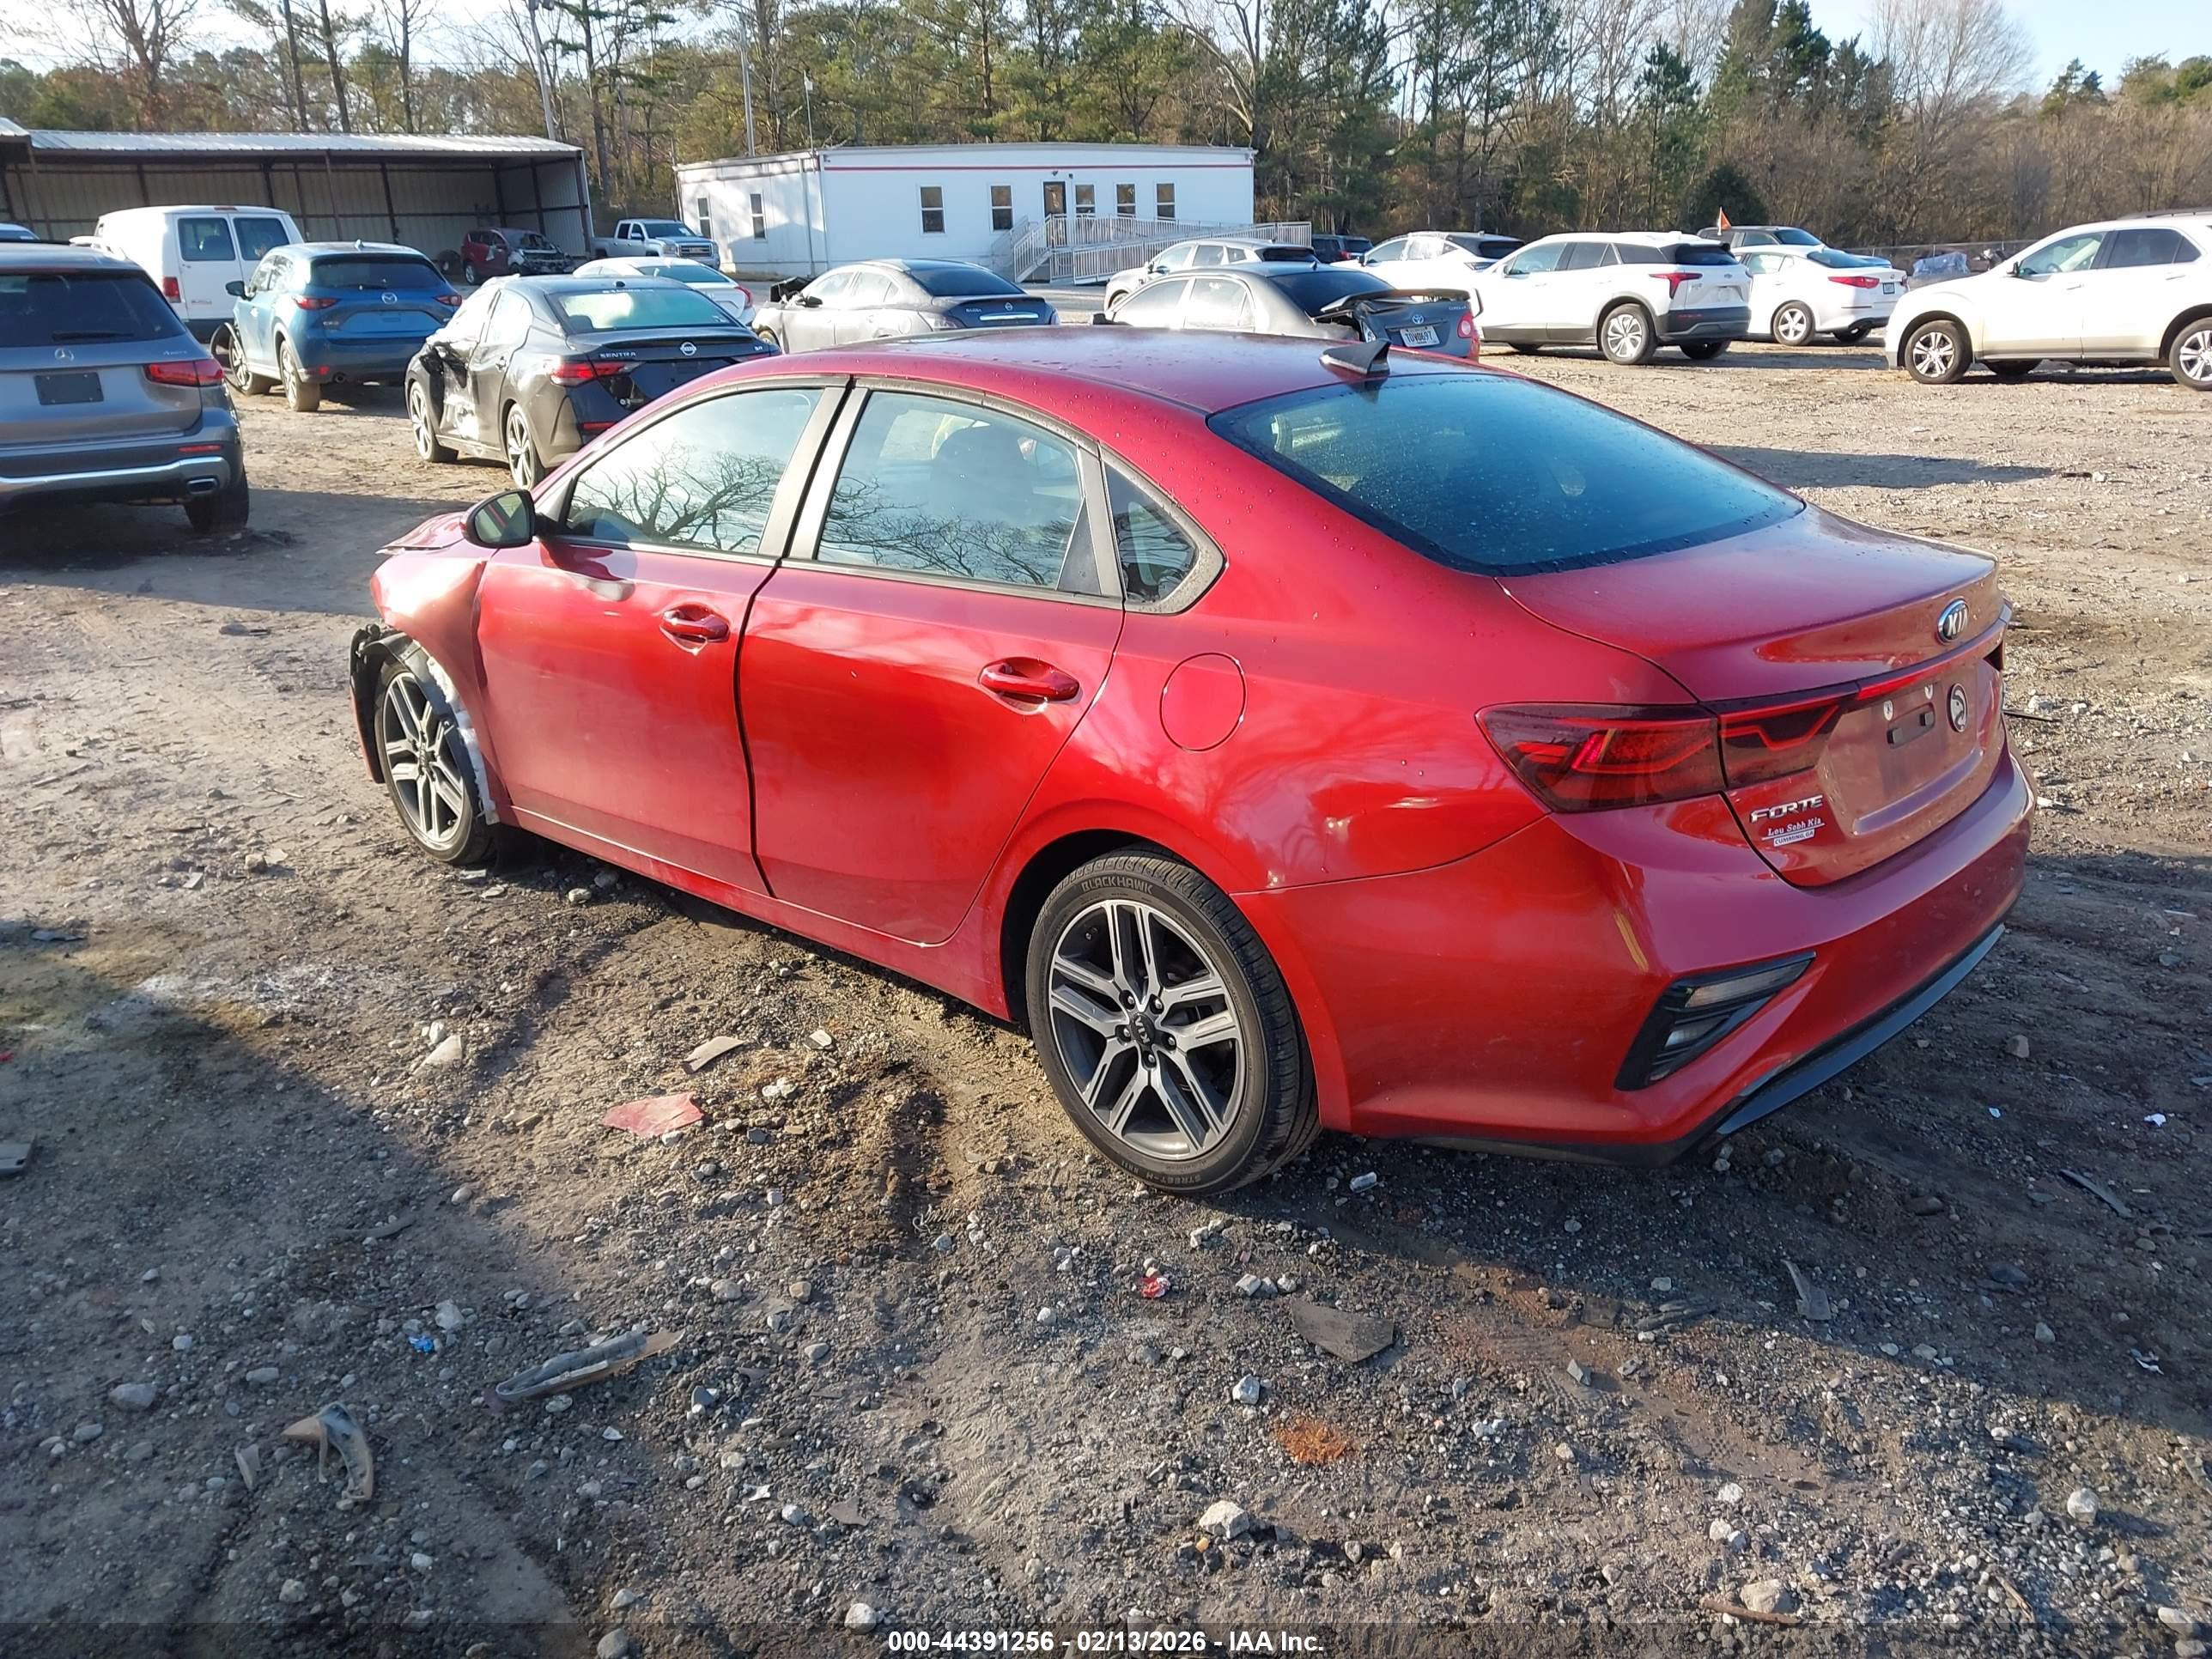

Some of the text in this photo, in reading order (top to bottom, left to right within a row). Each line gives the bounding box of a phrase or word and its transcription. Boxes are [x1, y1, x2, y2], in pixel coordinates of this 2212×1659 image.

[1947, 608, 1968, 636] KIA
[1750, 794, 1823, 823] FORTE
[1767, 828, 1784, 836] Lou
[1808, 817, 1821, 827] Kia
[1082, 876, 1154, 895] BLACKHAWK
[1134, 1016, 1151, 1044] KIA
[1146, 1170, 1202, 1185] STREET-H
